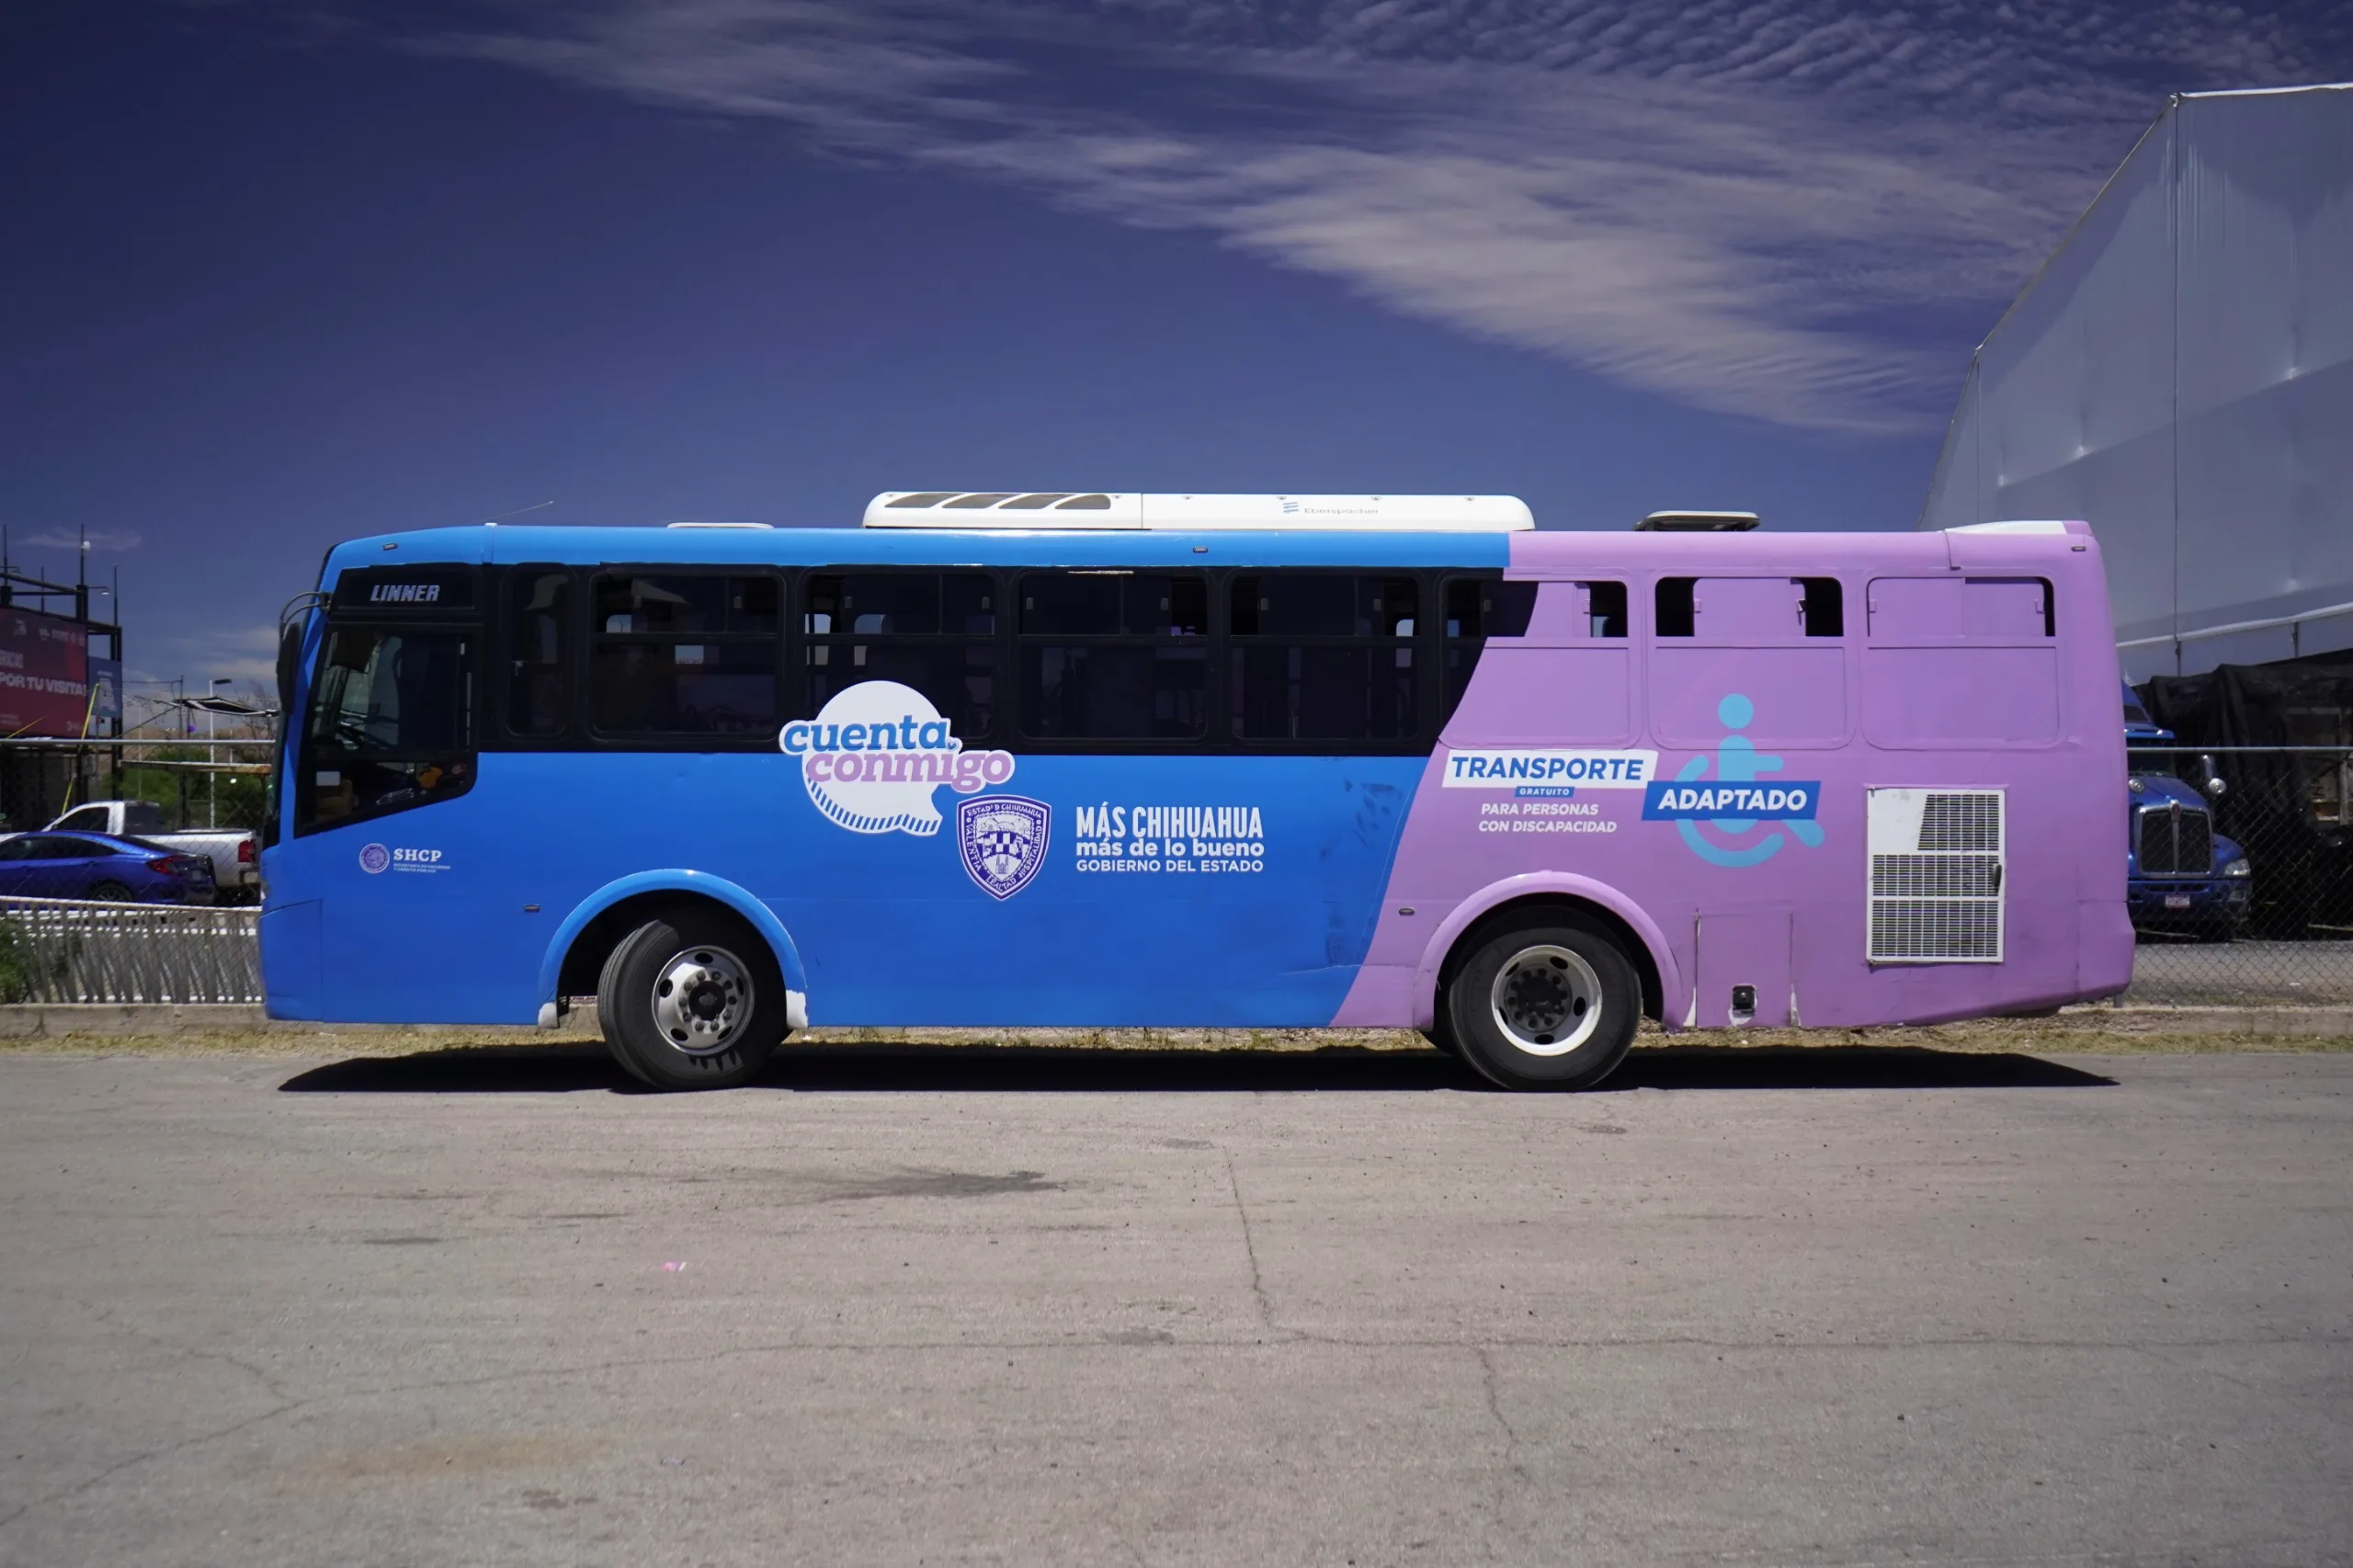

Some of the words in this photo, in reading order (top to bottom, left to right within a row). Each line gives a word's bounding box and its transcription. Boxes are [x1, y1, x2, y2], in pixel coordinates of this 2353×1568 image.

[370, 585, 440, 602] LINNER
[26, 676, 44, 691] TU
[783, 715, 948, 752] cuenta
[805, 752, 1012, 792] conmigo
[1452, 756, 1643, 780] TRANSPORTE
[1519, 788, 1570, 796] GRATUITO
[1658, 789, 1807, 811] ADAPTADO
[1481, 803, 1519, 815] PARA
[1522, 804, 1599, 816] PERSONAS
[1076, 801, 1126, 838] MÁS
[1132, 806, 1264, 838] CHIHUAHUA
[1479, 821, 1509, 833] CON
[1512, 821, 1618, 833] DISCAPACIDAD
[393, 848, 442, 862] SHCP
[1076, 837, 1123, 857] más
[1129, 838, 1158, 857] de
[1165, 838, 1187, 857] lo
[1192, 838, 1265, 857] bueno
[1076, 859, 1161, 872] GOBIERNO
[1165, 859, 1196, 872] DEL
[1200, 859, 1264, 872] ESTADO
